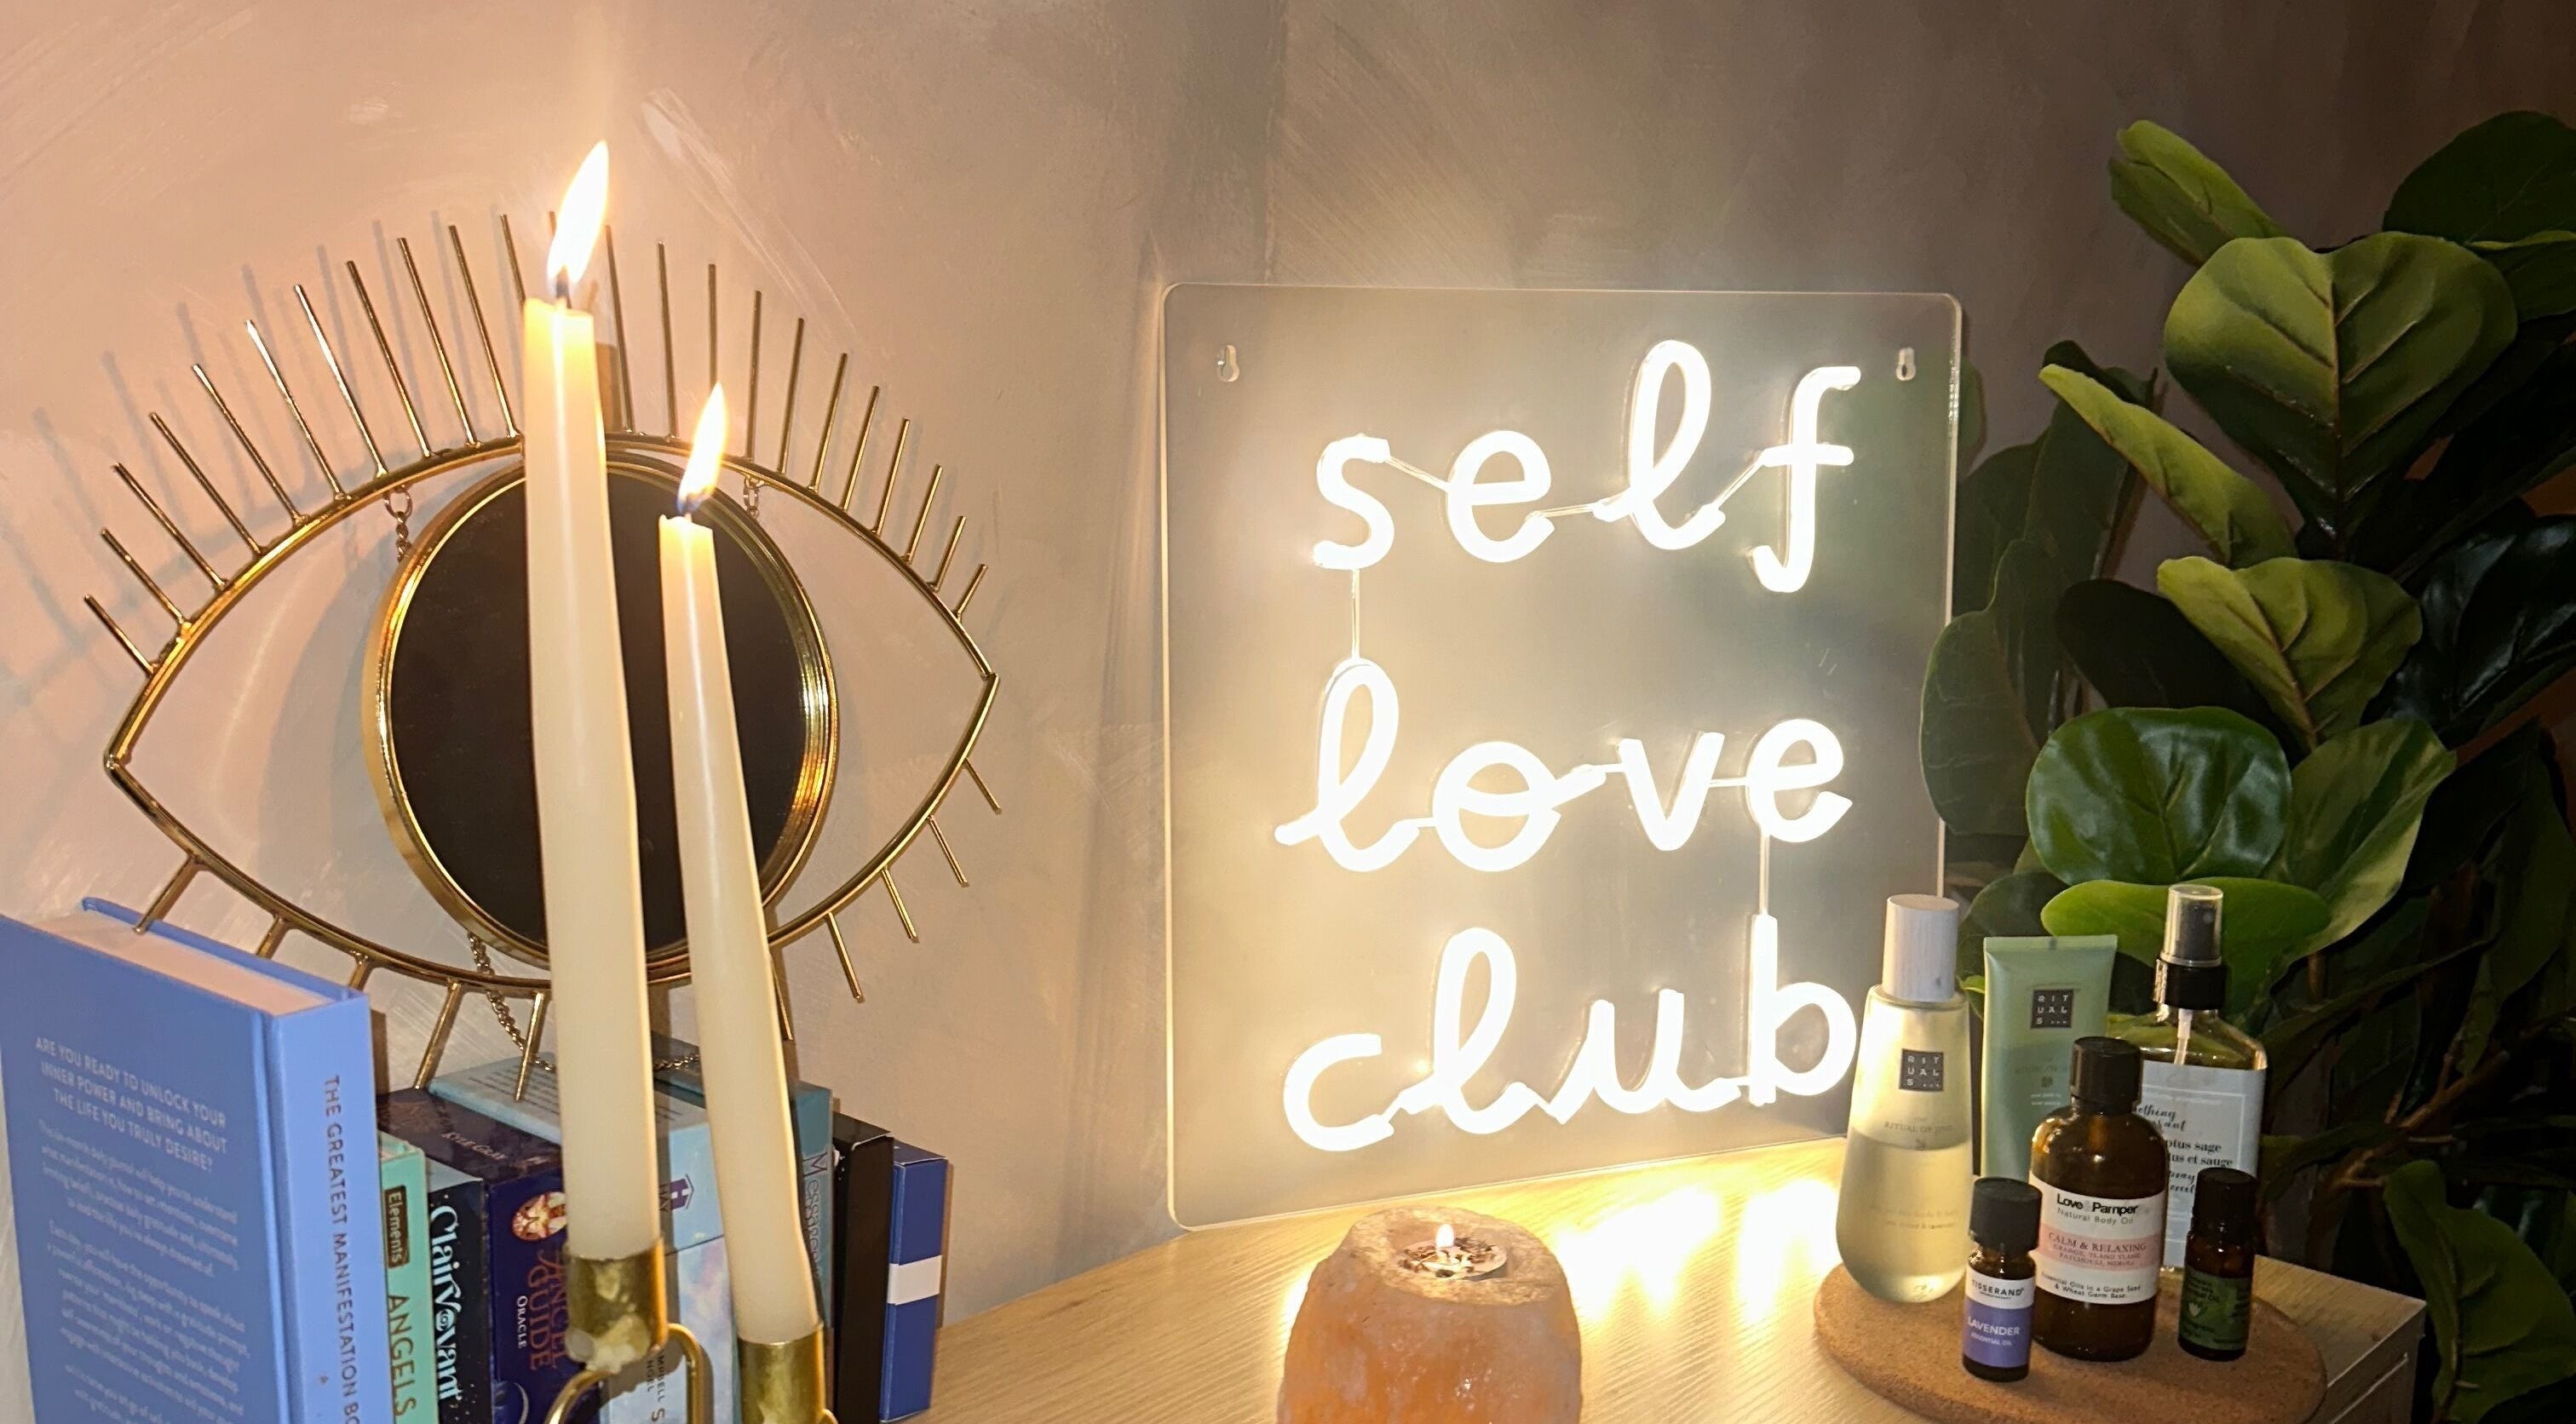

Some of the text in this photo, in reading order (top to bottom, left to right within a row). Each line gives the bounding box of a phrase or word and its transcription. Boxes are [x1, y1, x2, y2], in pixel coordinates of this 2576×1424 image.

[1311, 340, 1861, 593] self
[1274, 657, 1854, 873] love
[1283, 914, 1858, 1152] club
[35, 1036, 227, 1129] ARE YOU READY TO UNLOCK YOUR
[41, 1061, 227, 1154] INNER POWER AND BRING ABOUT
[325, 1074, 342, 1118] THE
[54, 1088, 213, 1174] THE LIFE YOU TRULY DESIRE?
[327, 1123, 348, 1225] GREATEST
[2194, 1142, 2222, 1155] sage
[388, 1191, 404, 1263] Elements
[2048, 1232, 2147, 1253] CALM & RELAXING
[2056, 1192, 2084, 1210] Love
[2091, 1202, 2139, 1217] Pamper
[2057, 1207, 2134, 1226] Natural Body Oil
[332, 1232, 359, 1398] MANIFESTATION
[516, 1295, 528, 1349] ORACLE
[527, 1266, 551, 1371] GUIDE
[1967, 1315, 2020, 1336] LAVENDER
[1971, 1279, 2022, 1296] TISSERAND
[388, 1294, 417, 1417] ANGELS
